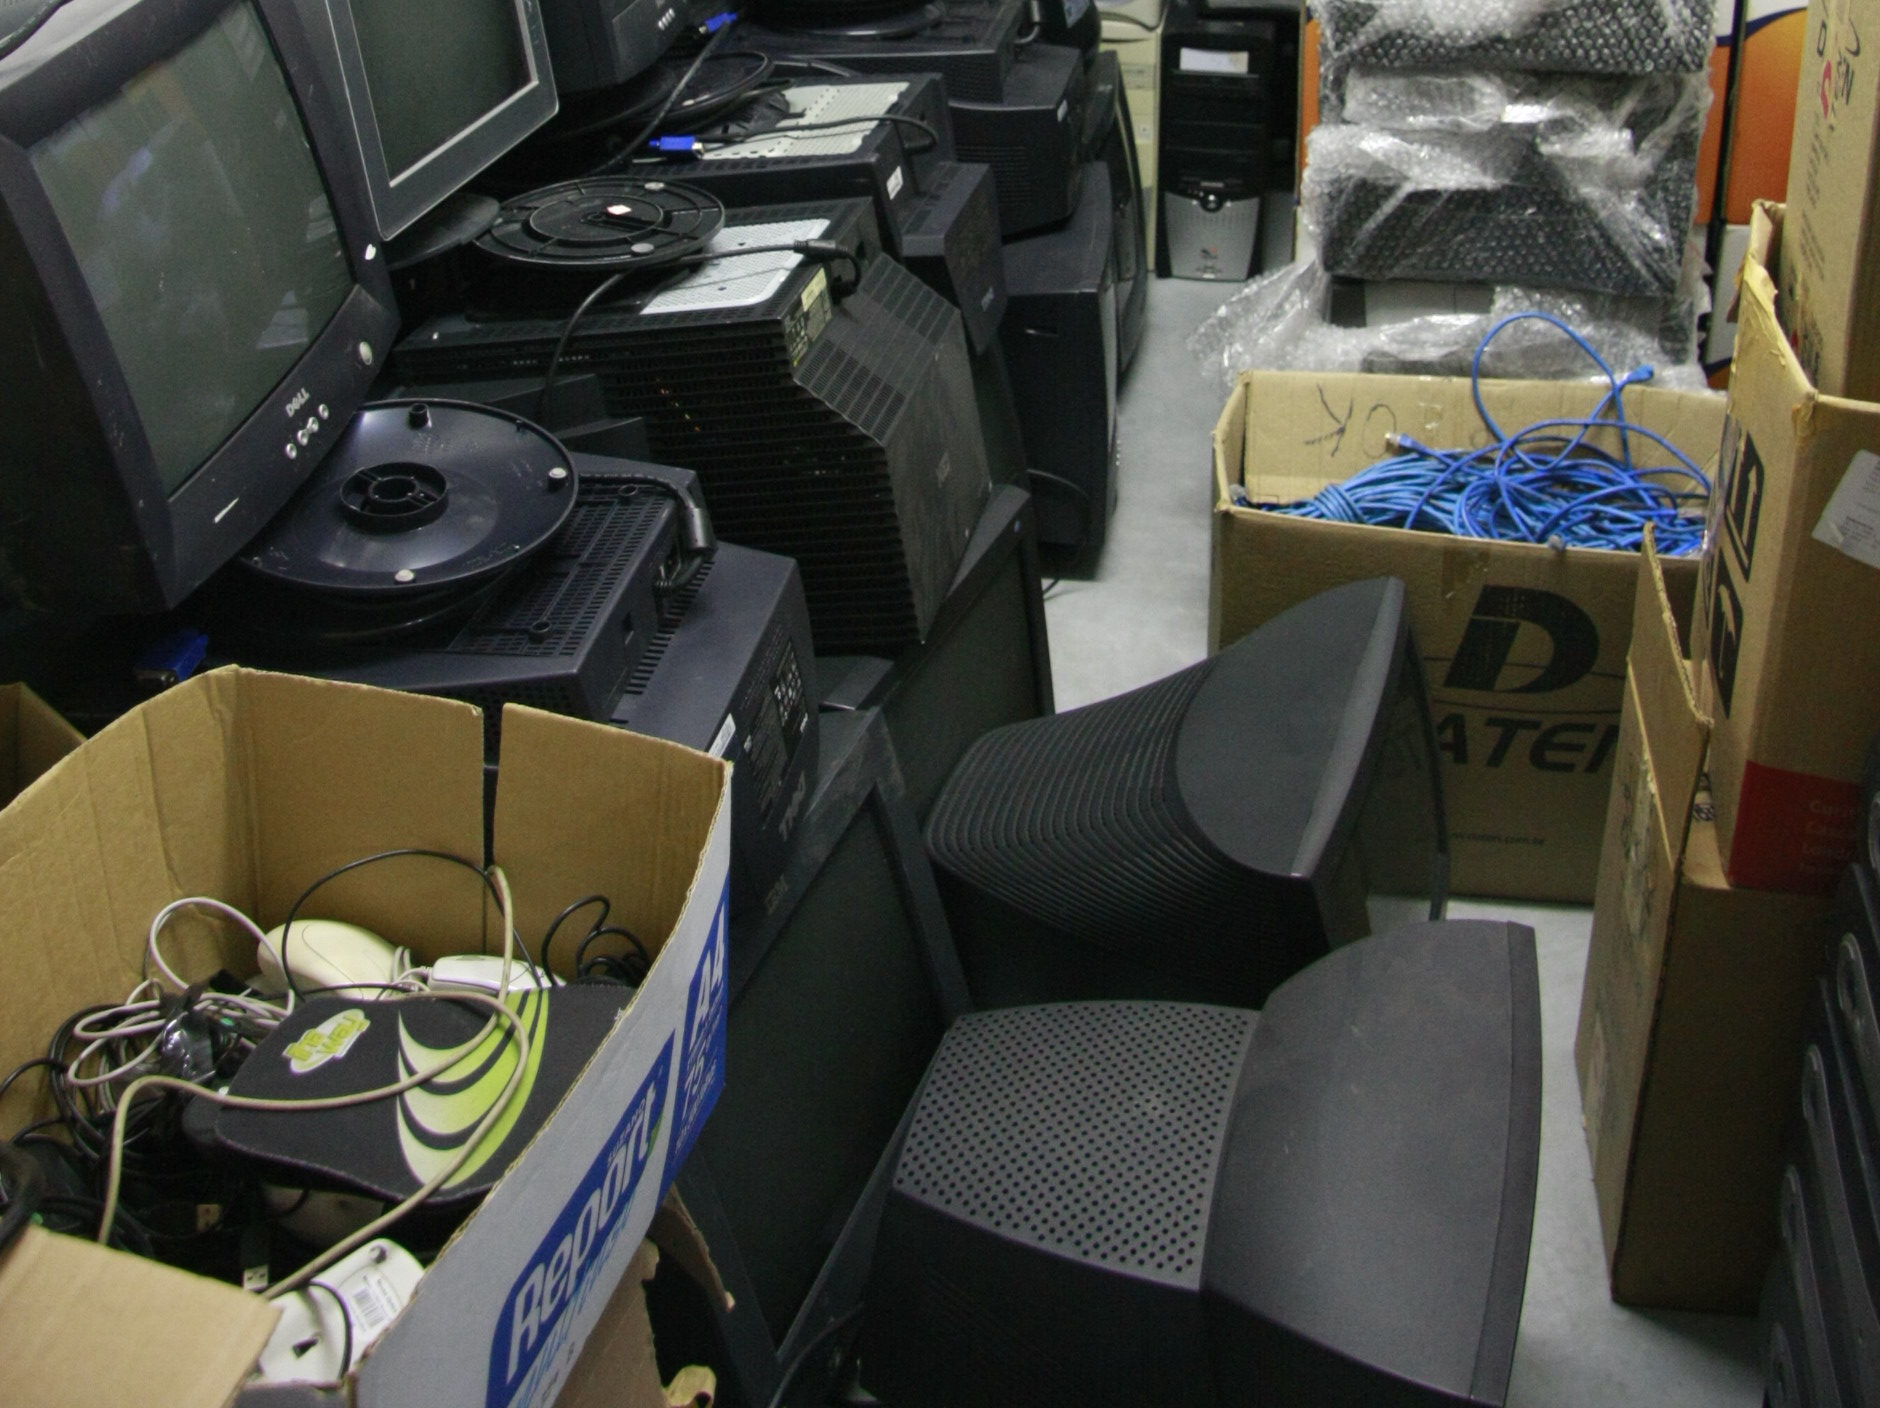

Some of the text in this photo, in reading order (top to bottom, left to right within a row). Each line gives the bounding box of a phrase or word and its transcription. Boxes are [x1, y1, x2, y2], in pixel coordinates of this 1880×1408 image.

[284, 386, 310, 418] DELL
[1437, 713, 1619, 774] ATE
[689, 902, 726, 1054] A4
[505, 1078, 659, 1389] Report
